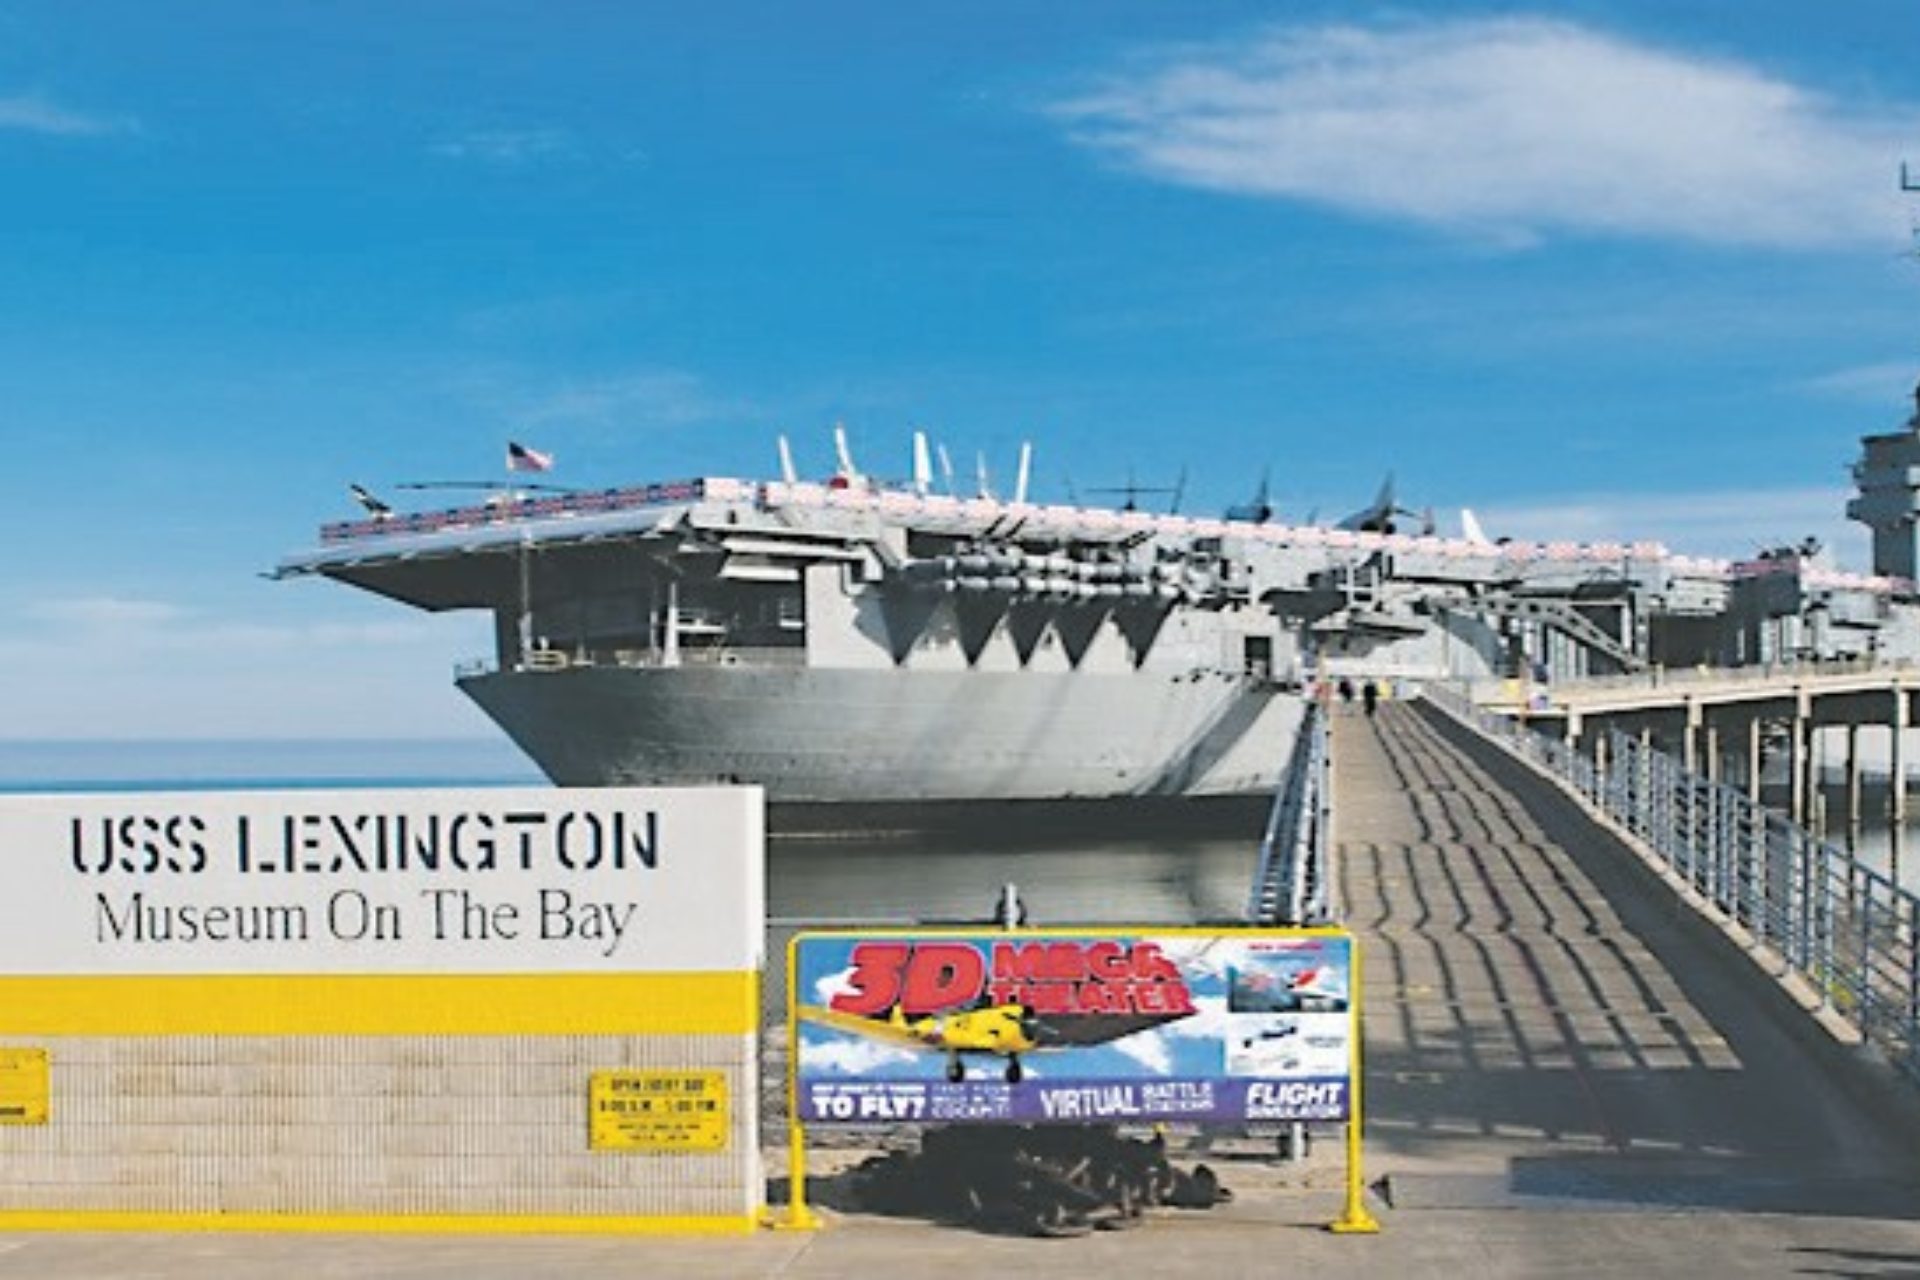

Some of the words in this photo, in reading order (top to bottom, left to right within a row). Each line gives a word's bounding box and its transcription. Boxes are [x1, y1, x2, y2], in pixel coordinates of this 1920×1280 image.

[71, 815, 207, 873] USS
[237, 811, 658, 873] LEXINGTON
[97, 892, 308, 943] Museum
[327, 889, 402, 940] On
[420, 889, 519, 940] The
[538, 889, 638, 957] Bay
[830, 942, 986, 1015] 3D
[993, 942, 1183, 979] MEGA
[988, 982, 1198, 1014] THEATER
[1039, 1085, 1141, 1118] VIRTUAL
[1142, 1082, 1213, 1099] BATTLE
[1247, 1082, 1344, 1105] FLIGHT
[812, 1096, 854, 1118] TO
[860, 1096, 926, 1119] FLY?
